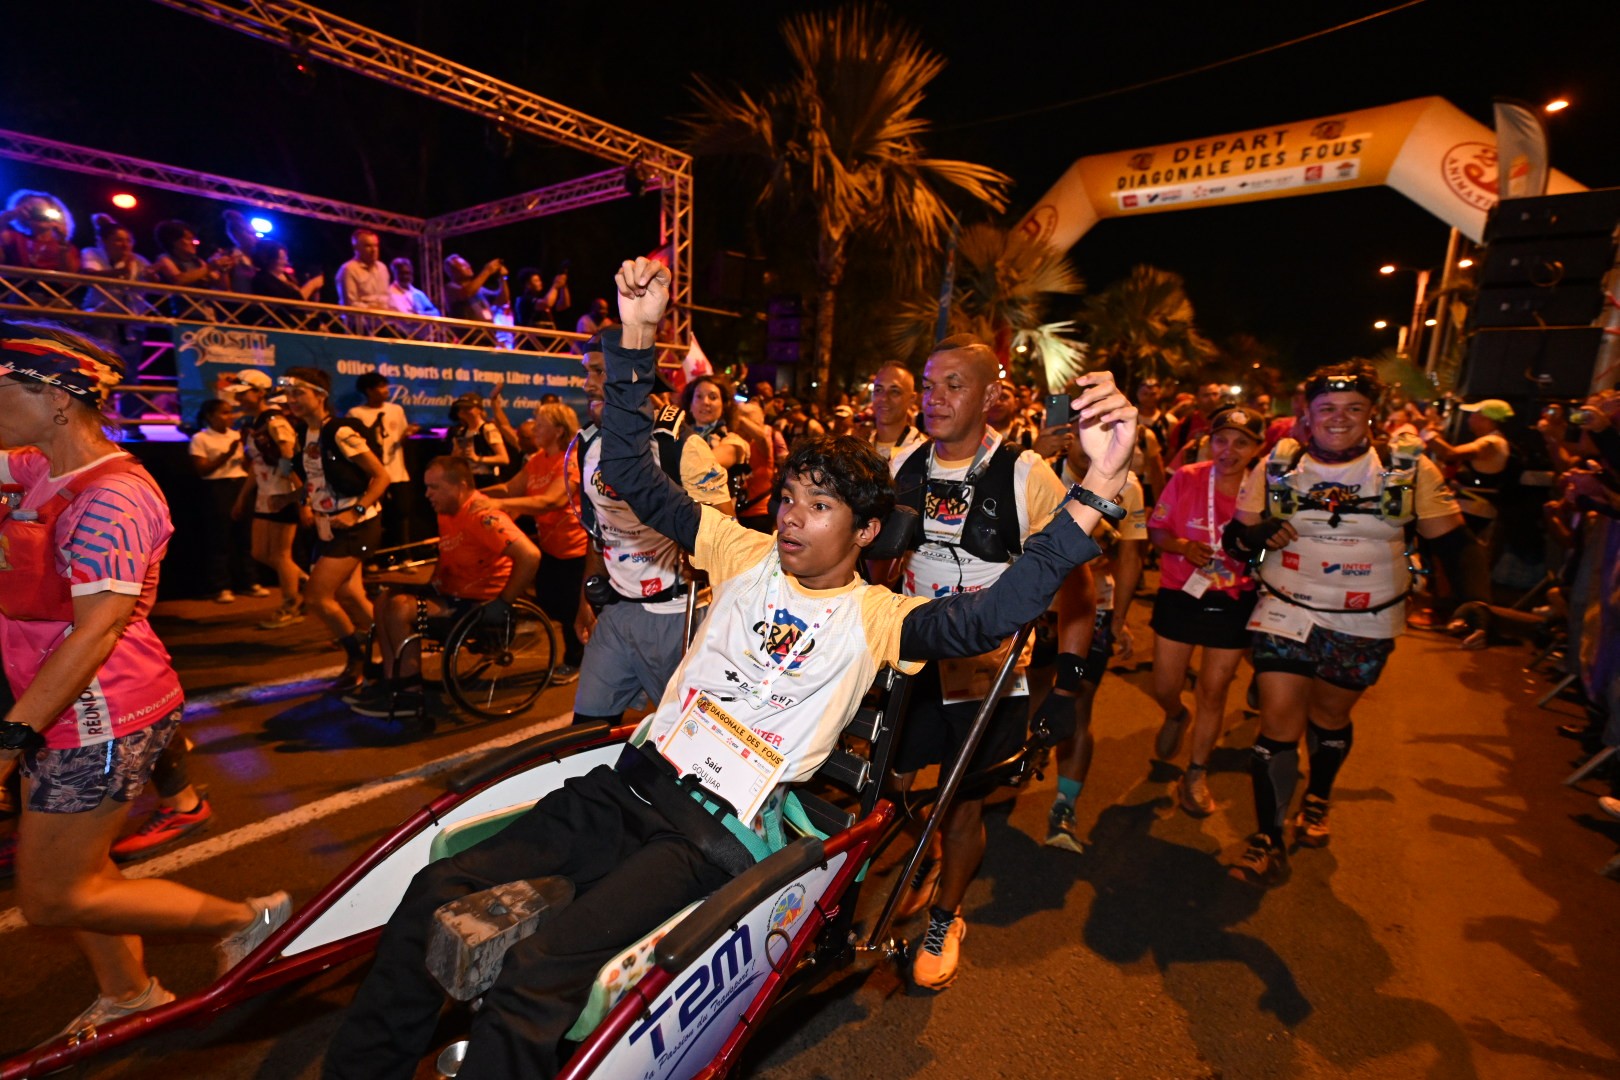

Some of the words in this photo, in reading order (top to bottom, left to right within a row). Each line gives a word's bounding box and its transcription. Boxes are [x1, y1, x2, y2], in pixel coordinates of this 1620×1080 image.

[1117, 159, 1232, 189] DIAGONALE
[1244, 151, 1287, 170] DES
[1300, 139, 1363, 162] FOUS
[1173, 130, 1289, 163] DEPART
[336, 359, 376, 376] Office
[378, 362, 401, 378] des
[402, 363, 440, 380] Sports
[441, 367, 454, 380] et
[455, 367, 470, 381] du
[472, 368, 505, 384] Temps
[506, 370, 531, 384] Libre
[532, 372, 545, 385] de
[79, 687, 104, 736] RÉUNIO
[710, 705, 746, 736] DIAGONALE
[746, 734, 761, 748] DES
[761, 746, 781, 765] FOUS
[704, 757, 723, 773] Said
[628, 924, 753, 1060] T2M
[658, 1029, 693, 1070] Passion
[696, 1013, 708, 1028] du
[709, 969, 748, 1012] Transport
